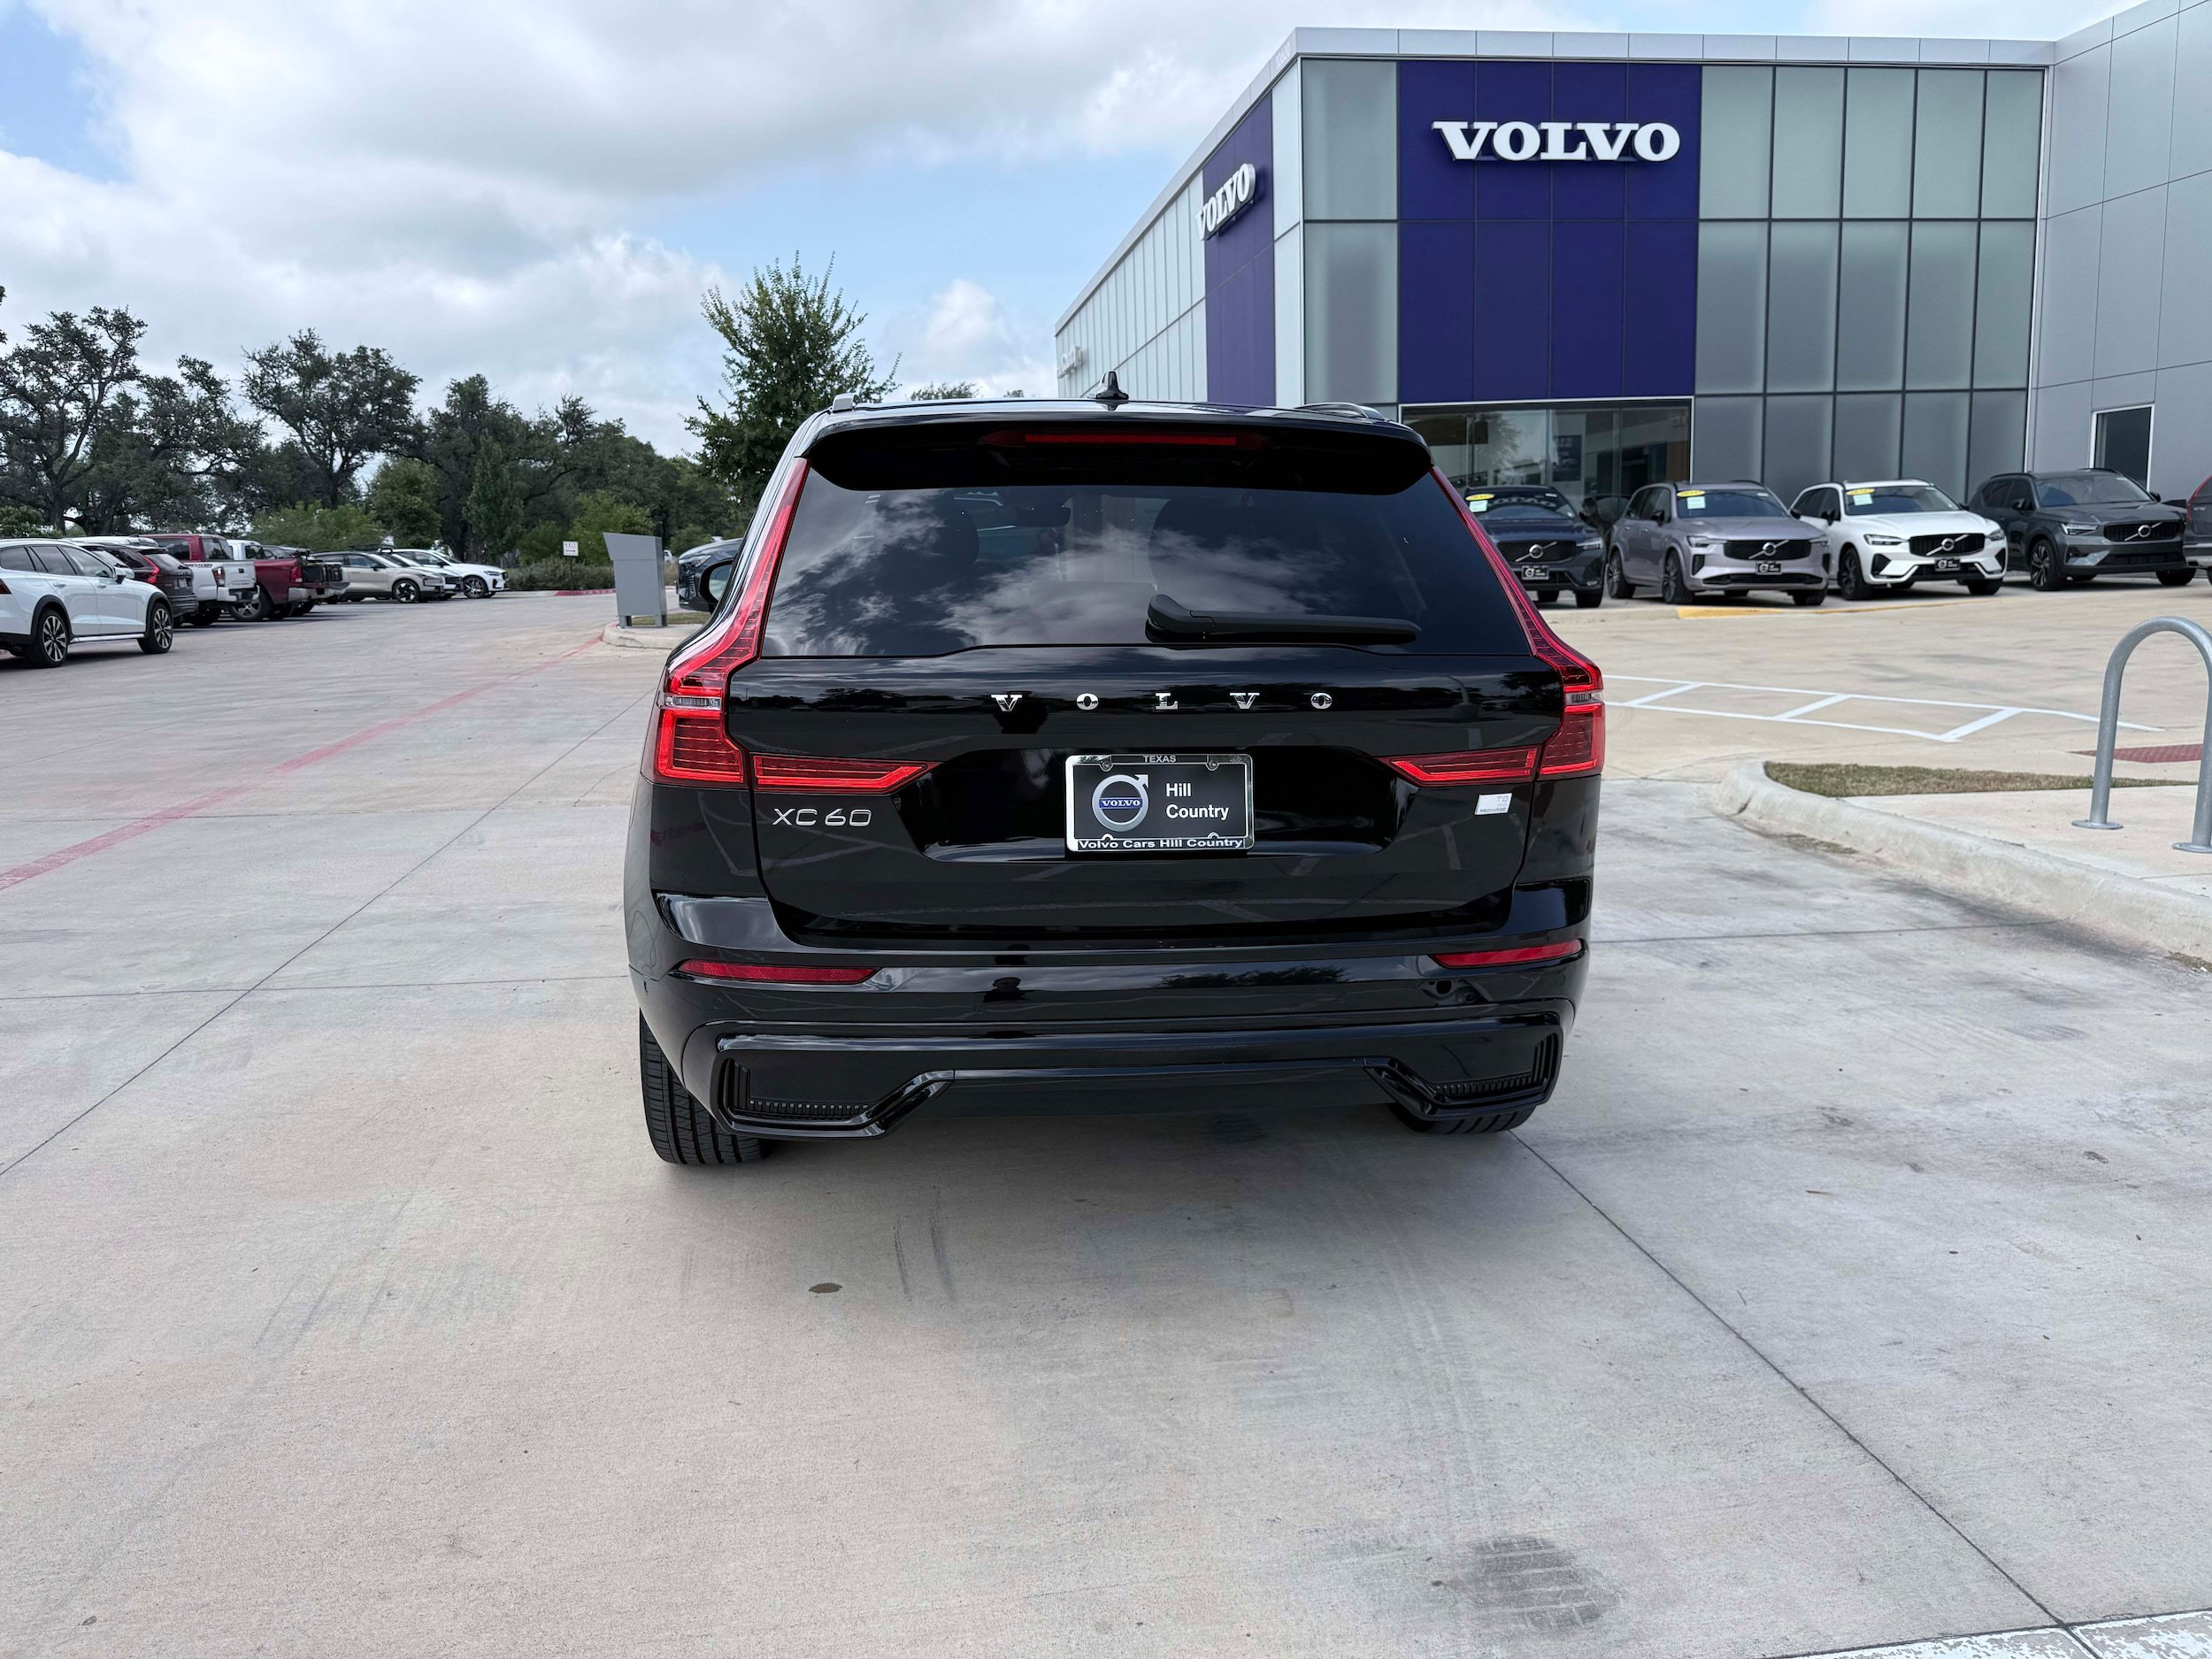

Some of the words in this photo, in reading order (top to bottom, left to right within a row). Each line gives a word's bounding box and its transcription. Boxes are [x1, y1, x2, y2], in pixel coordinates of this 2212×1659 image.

[1432, 120, 1680, 162] VOLVO
[1195, 163, 1256, 241] VOLVO
[990, 693, 1333, 712] VOLVO
[1166, 783, 1192, 797] Hill
[1101, 799, 1141, 808] VOLVO
[1166, 804, 1230, 821] Country
[772, 808, 872, 827] XC60
[1079, 840, 1118, 849] Volvo
[1123, 840, 1156, 849] Cars
[1160, 839, 1183, 849] Hill
[1187, 838, 1243, 849] Country
